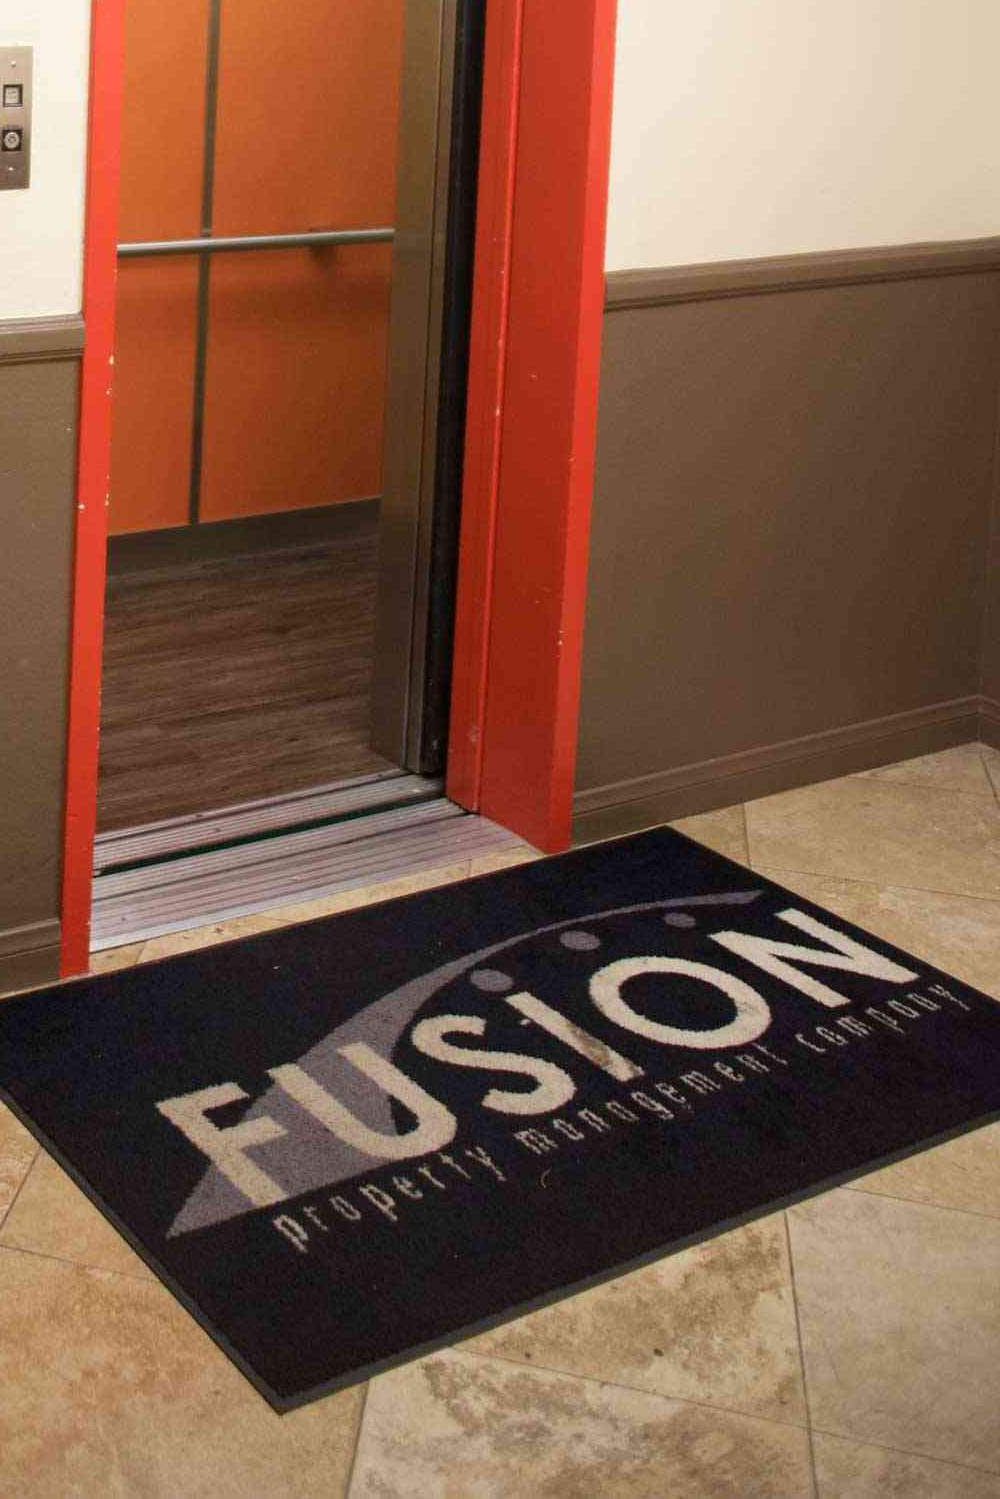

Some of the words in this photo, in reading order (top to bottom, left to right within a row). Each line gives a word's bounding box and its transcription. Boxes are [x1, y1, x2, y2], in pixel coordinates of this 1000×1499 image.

[156, 909, 919, 1206] FUSION
[272, 1143, 508, 1253] property
[515, 1043, 793, 1156] management
[796, 981, 972, 1054] company
